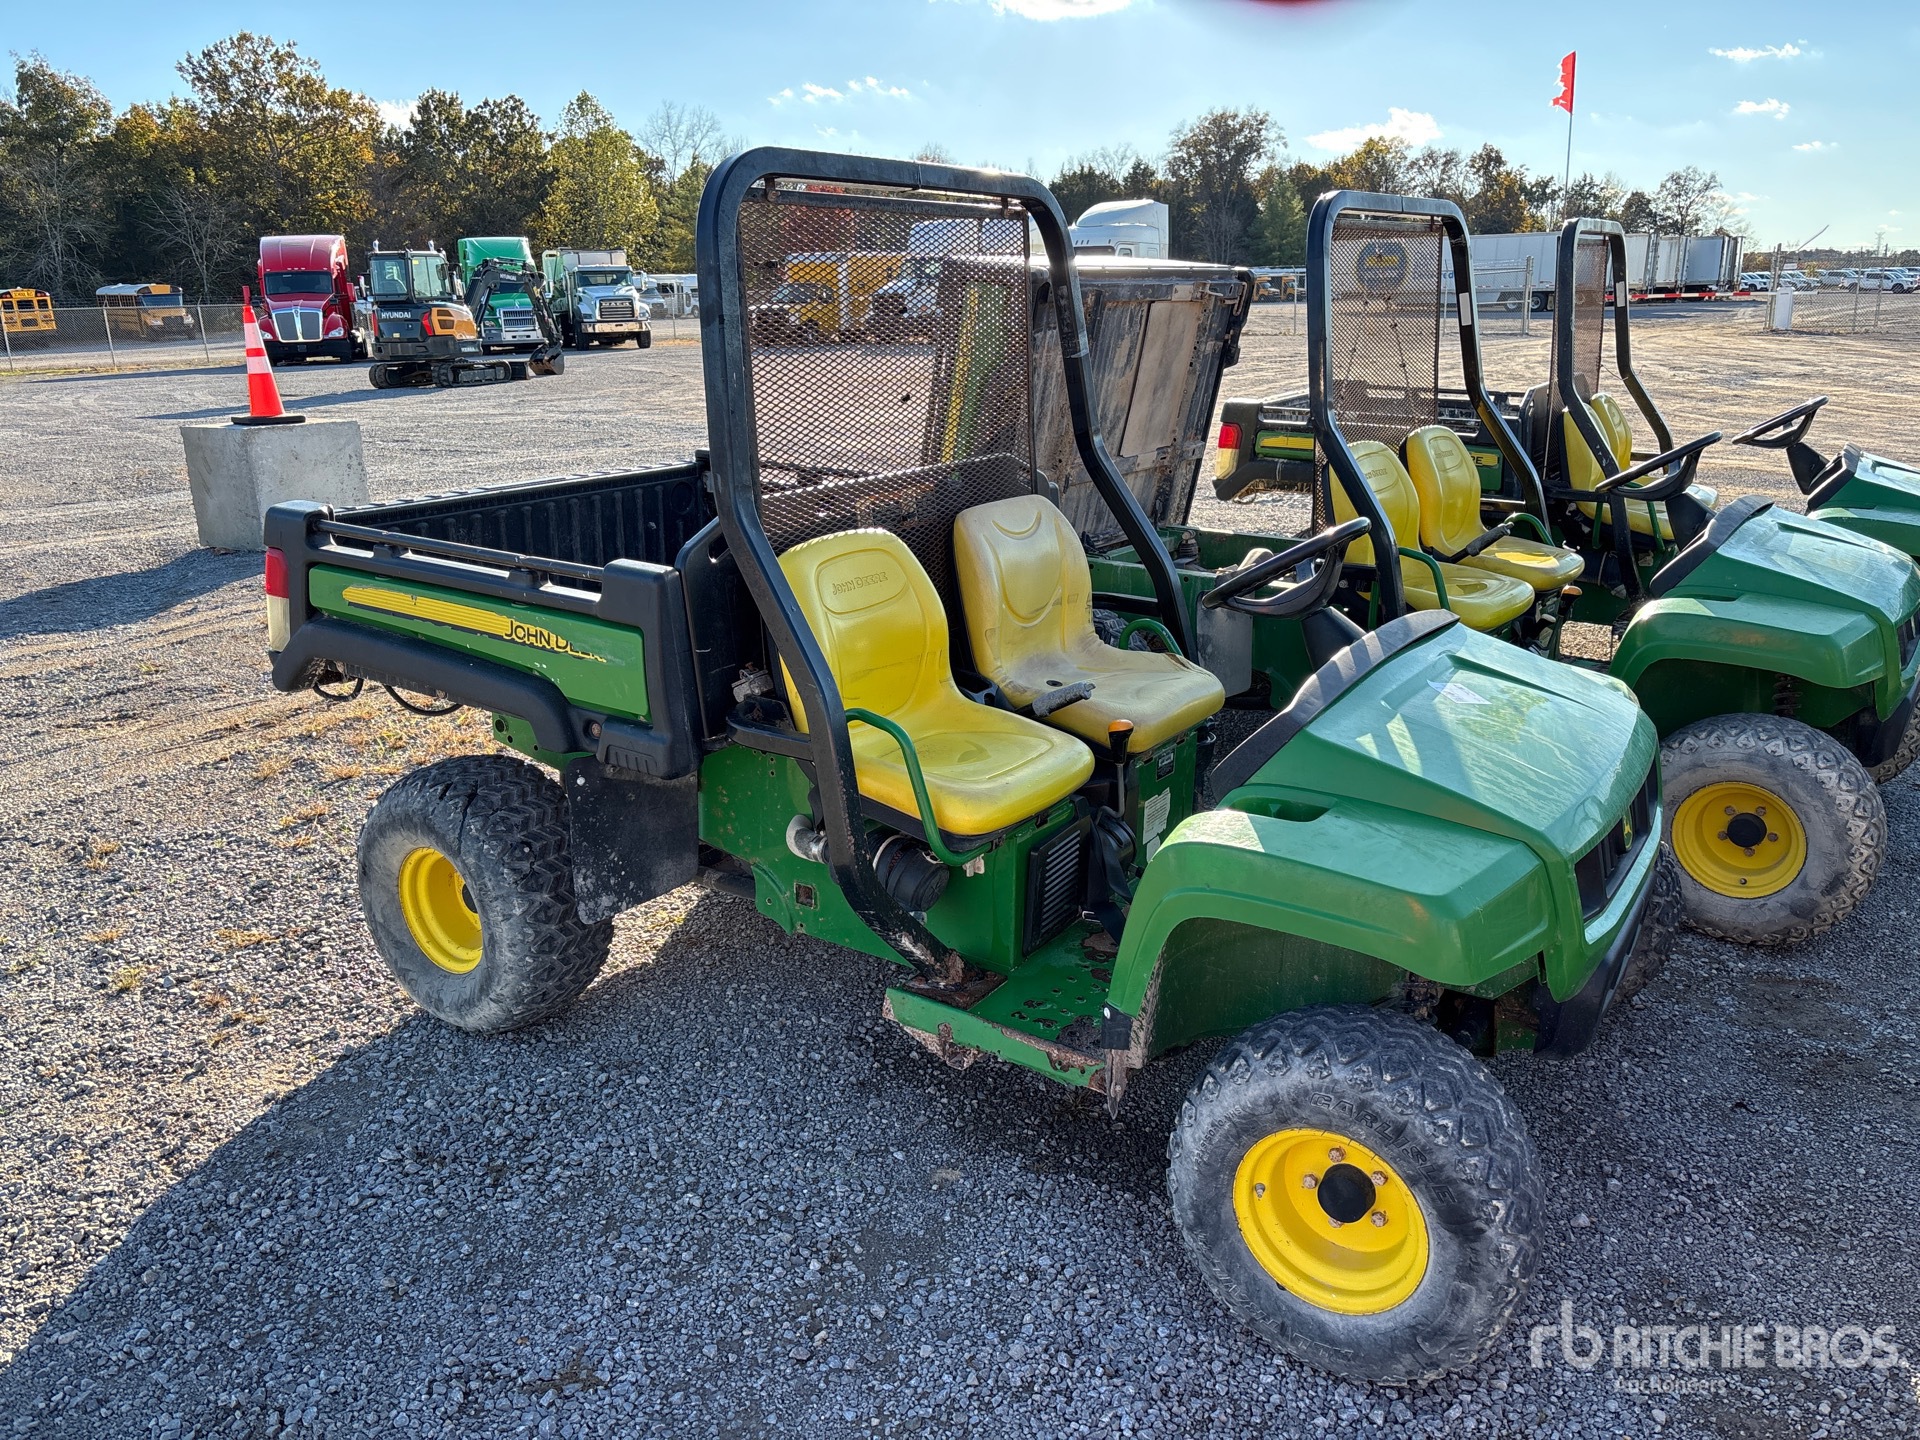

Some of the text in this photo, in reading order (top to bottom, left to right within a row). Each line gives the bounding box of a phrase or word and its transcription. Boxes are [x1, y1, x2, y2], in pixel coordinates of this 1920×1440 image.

[381, 311, 411, 319] HYUNDAI
[832, 571, 888, 595] JOHN DEERE
[505, 620, 552, 647] JOHN
[1310, 1093, 1457, 1205] CARLISLE
